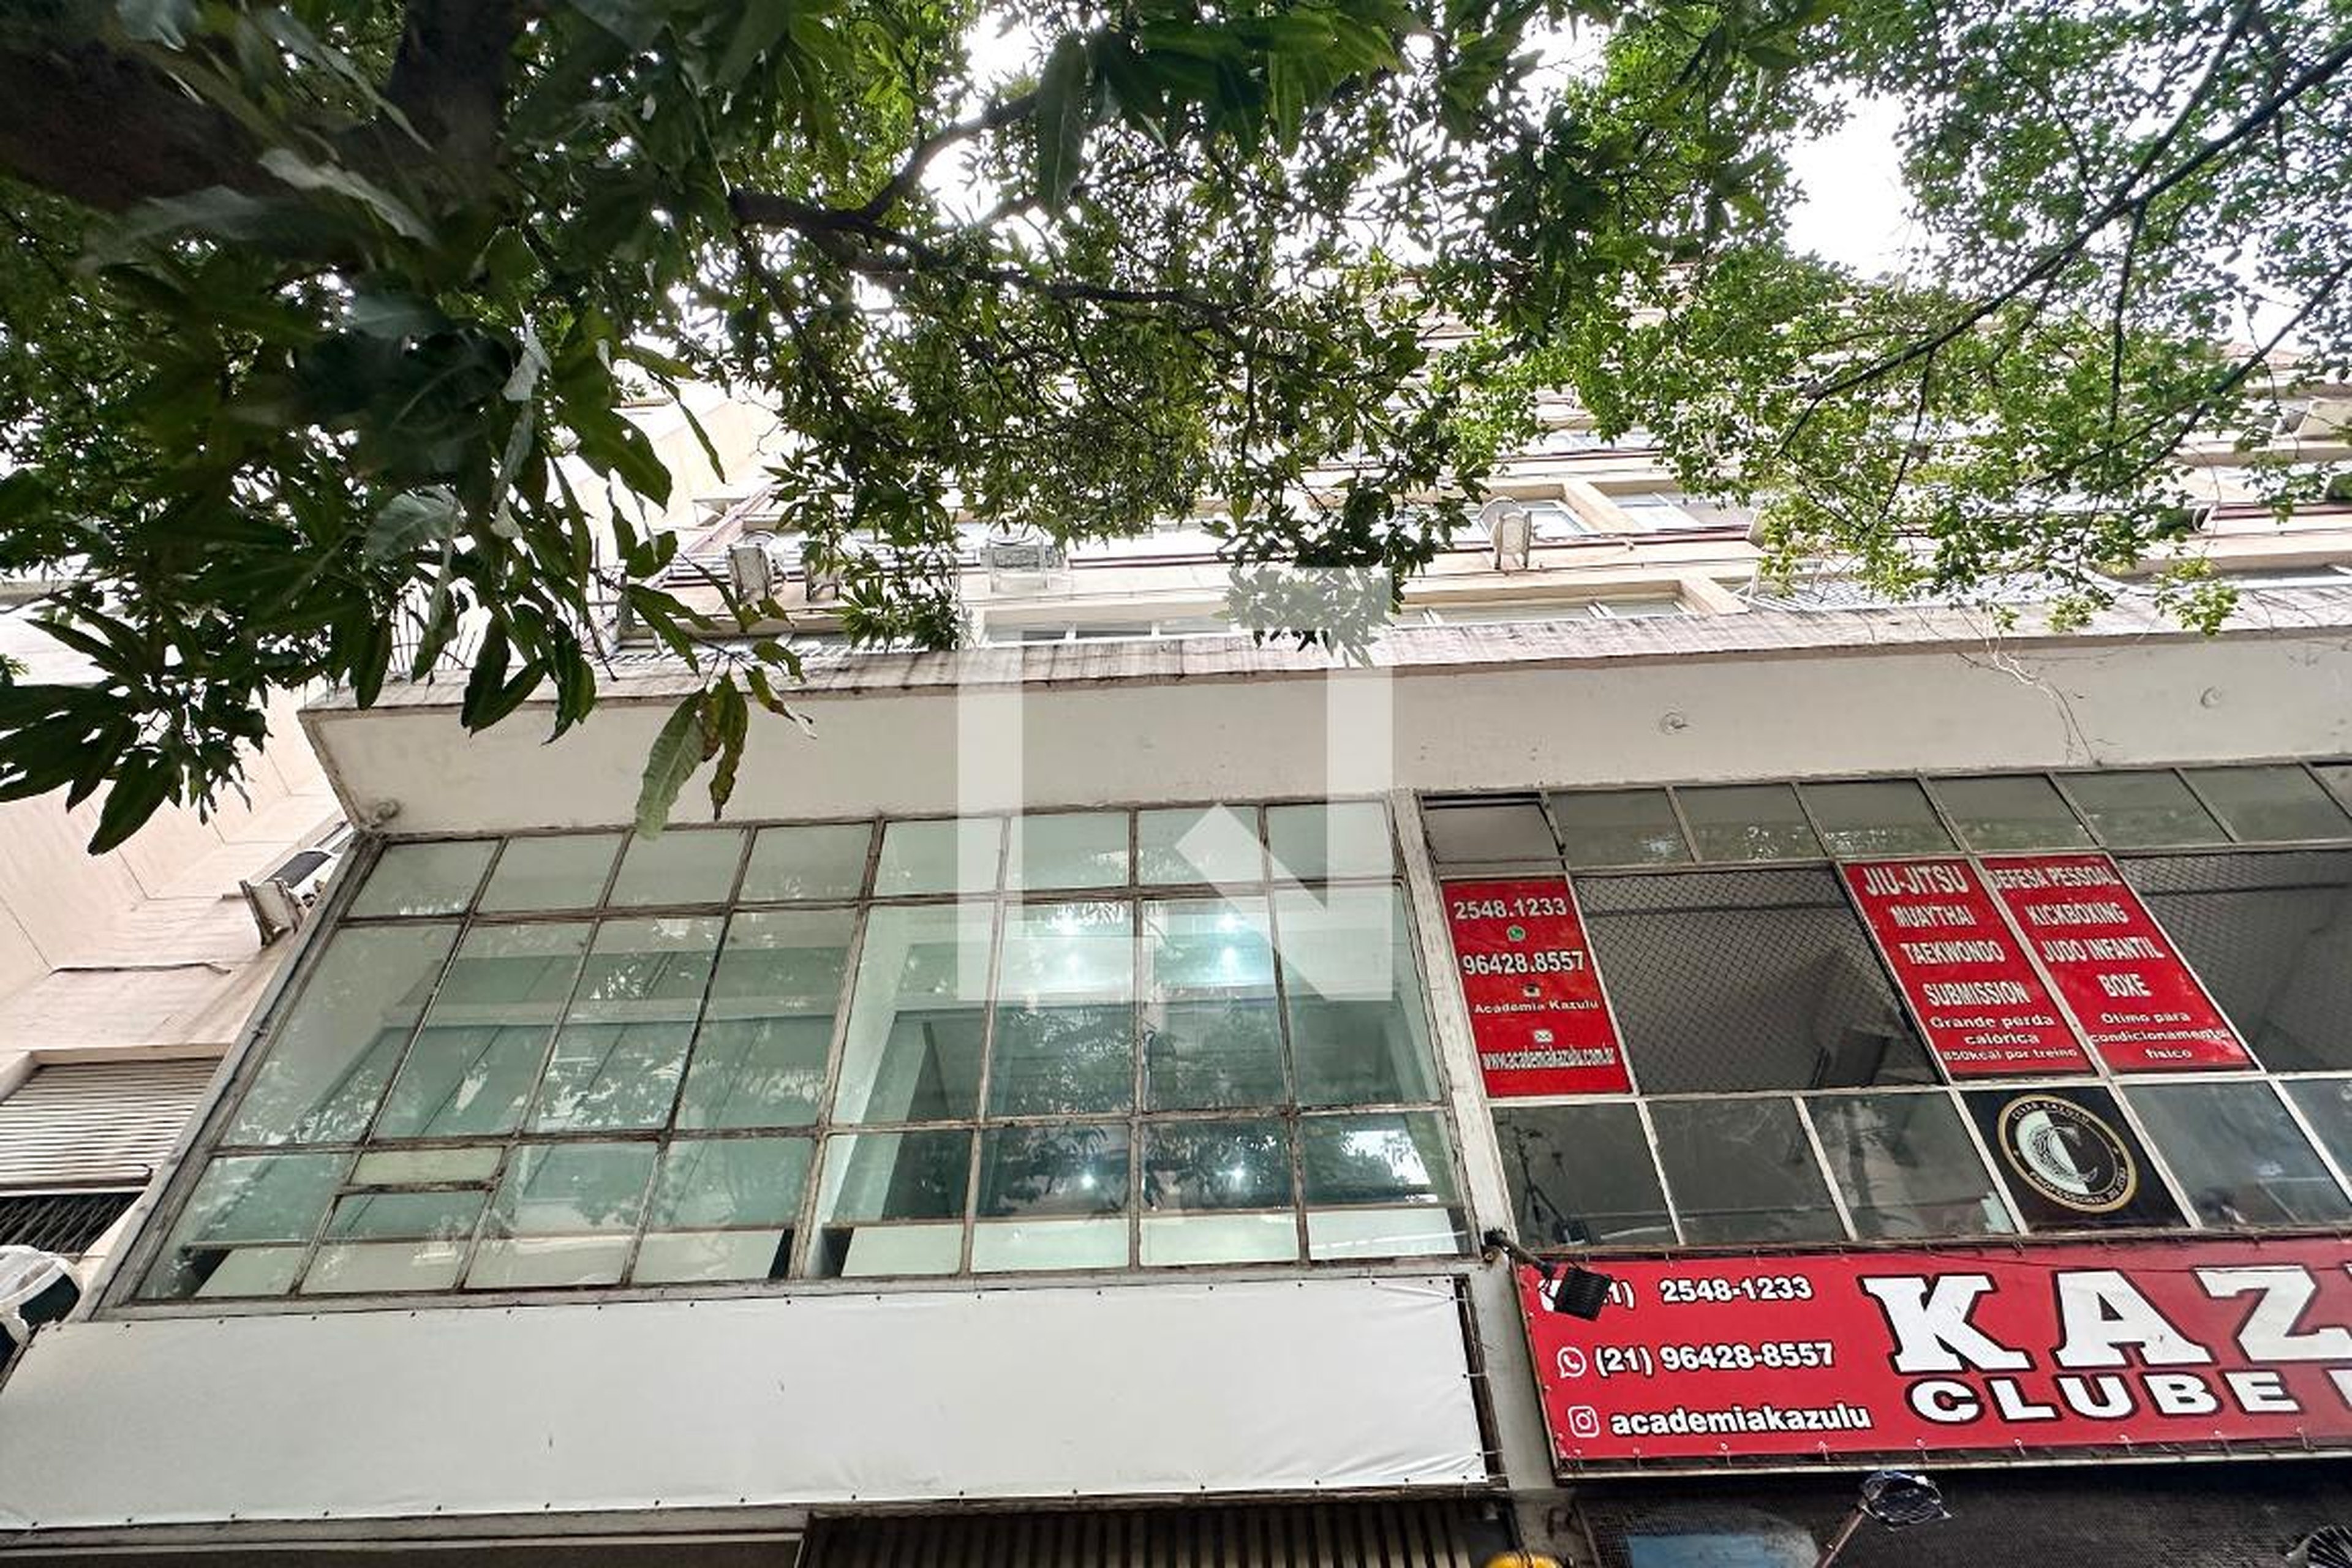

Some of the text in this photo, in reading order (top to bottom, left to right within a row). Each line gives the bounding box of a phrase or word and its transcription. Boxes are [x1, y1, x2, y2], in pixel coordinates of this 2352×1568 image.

[1863, 864, 1970, 896] JIU-JITSU
[1987, 865, 2122, 889] DEFESA PESSOAL
[1453, 898, 1567, 919] 2548.1233
[1890, 905, 1977, 927] MUAYTHAI
[2025, 902, 2129, 925] KICKBOXING
[1900, 940, 2005, 964] TAEKWONDO
[2041, 936, 2165, 962] JUDO INFANTIL
[1463, 951, 1584, 975] 96428.8557
[1923, 981, 2031, 1006] SUBMISSION
[2097, 973, 2152, 997] BOXE
[1549, 1000, 1598, 1009] Kazulu
[1929, 1014, 2054, 1030] Grande perda
[2153, 1012, 2191, 1023] para
[2005, 1050, 2029, 1060] por
[1660, 1276, 1812, 1302] 2548-1233
[1860, 1264, 2352, 1373] KAZ
[1596, 1342, 1832, 1377] (21) 96428-8557
[1909, 1370, 2301, 1423] CLUBE
[1611, 1403, 1872, 1434] academiakazulu
